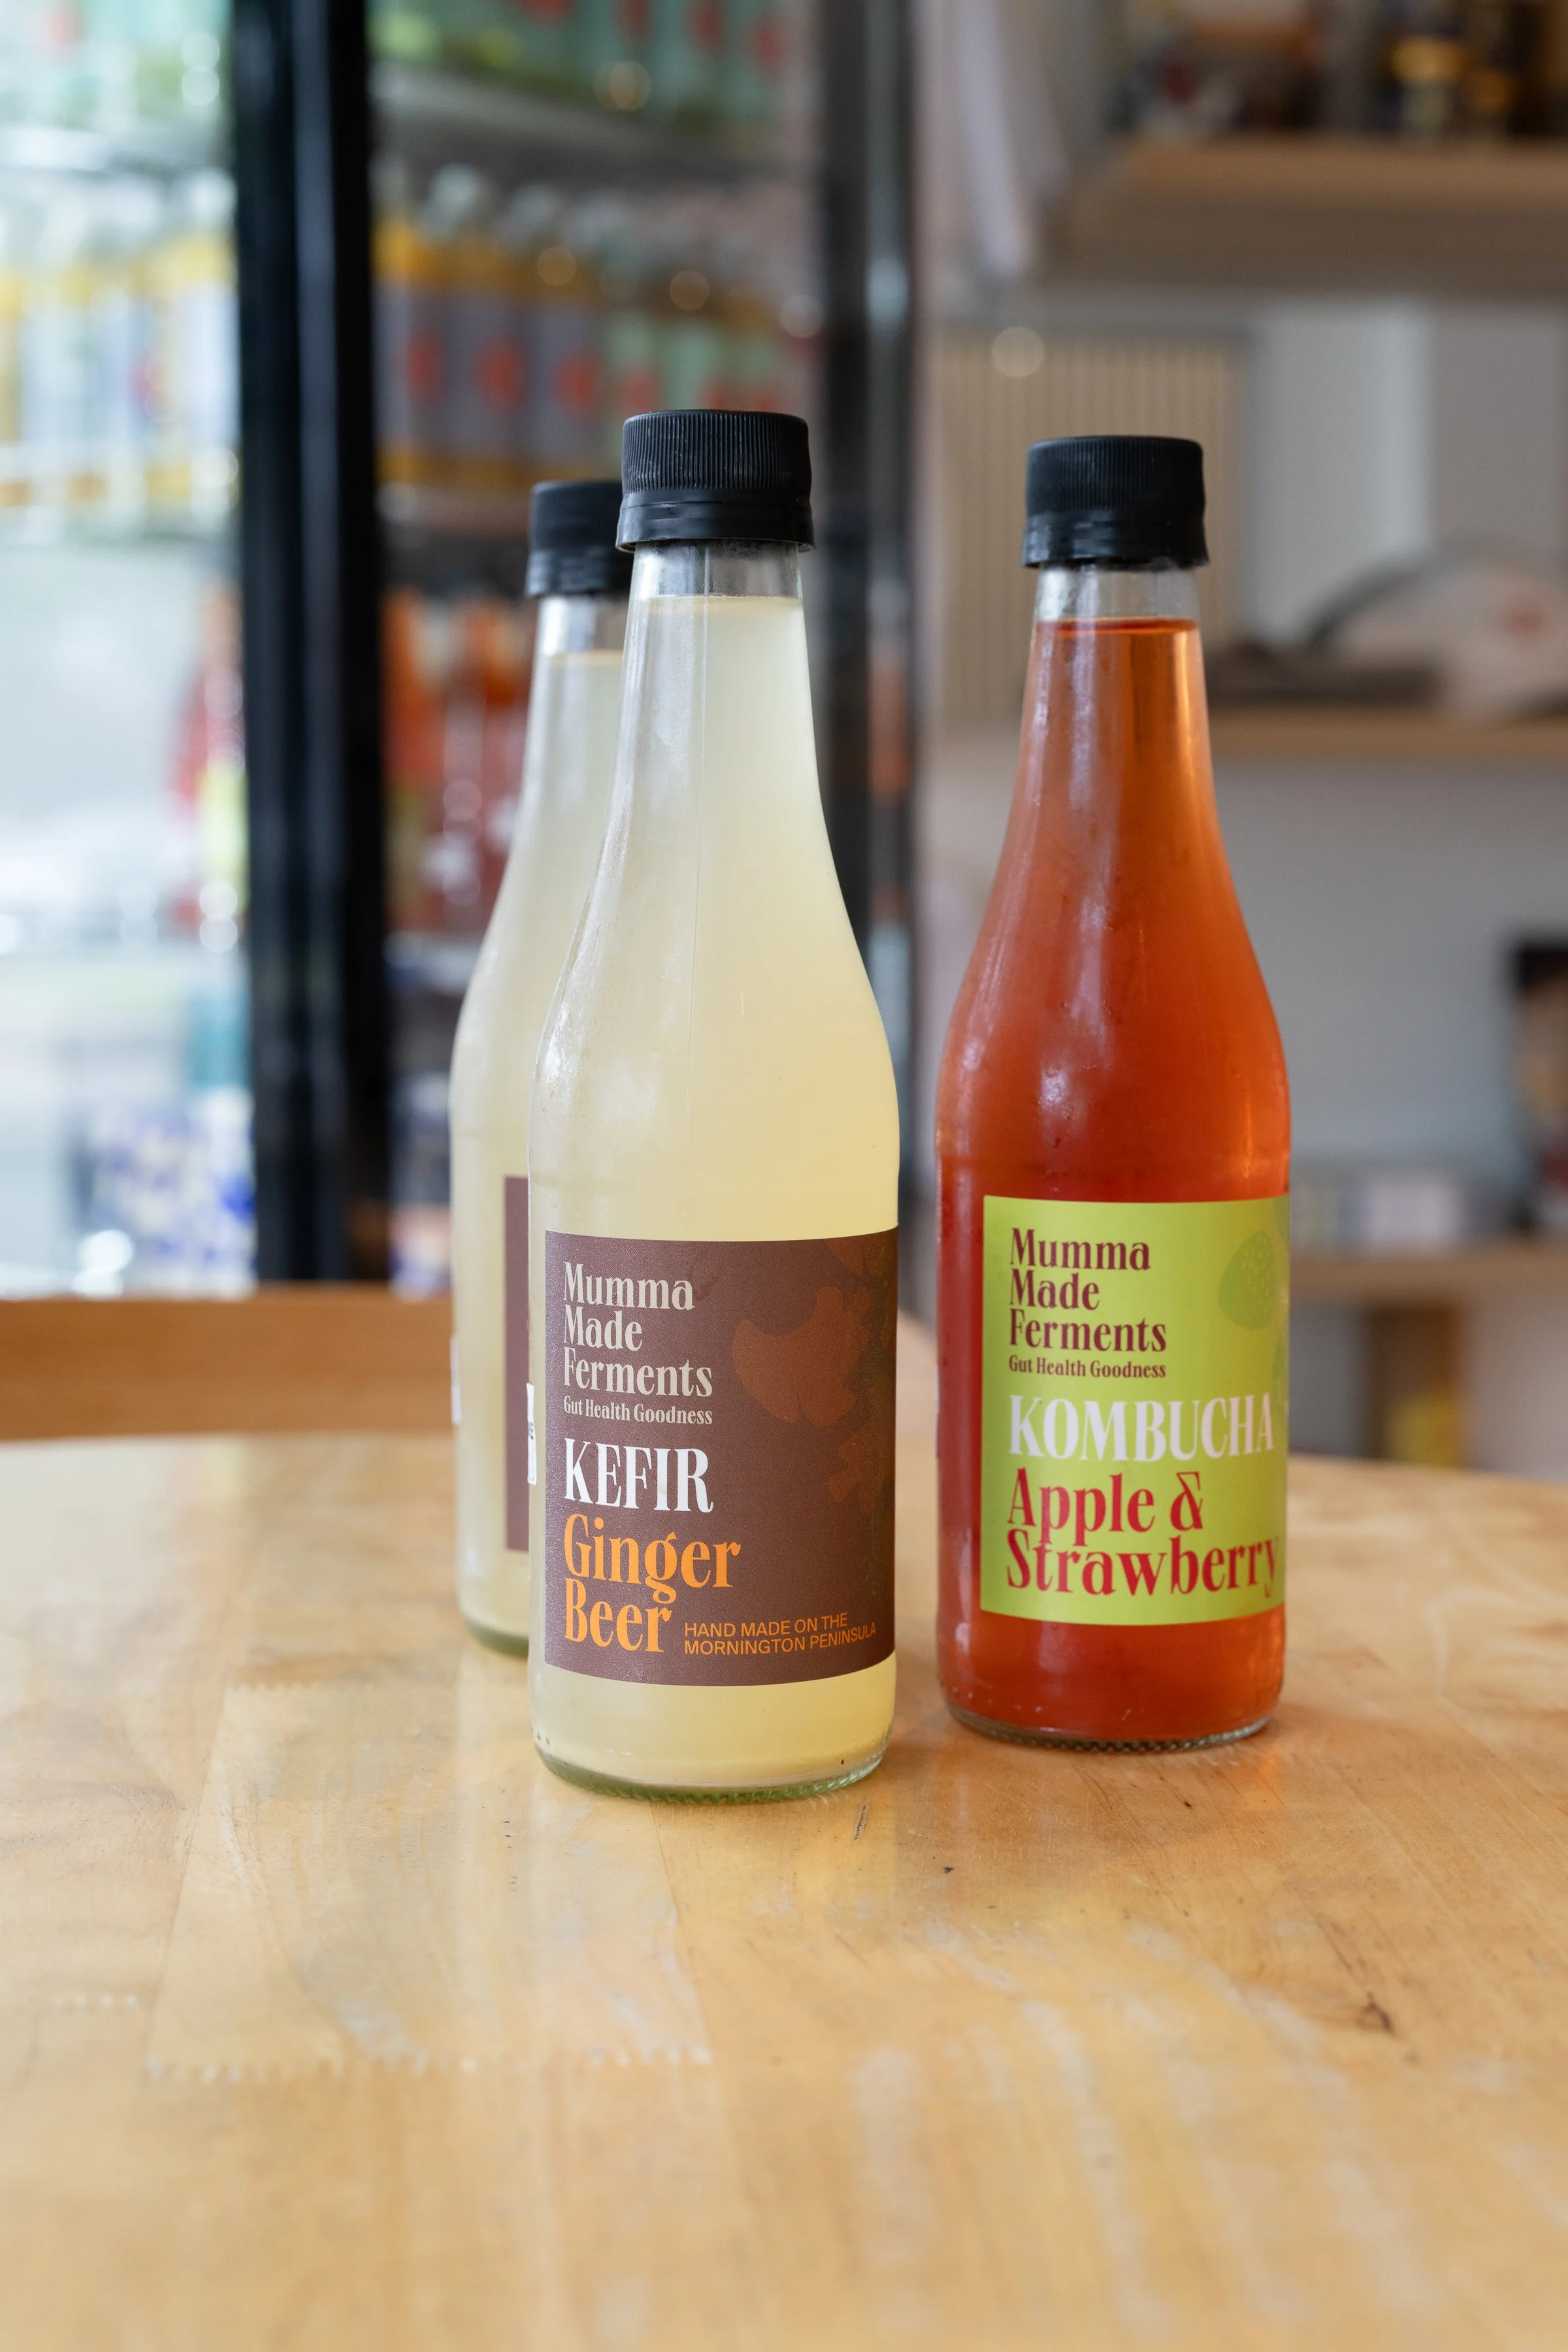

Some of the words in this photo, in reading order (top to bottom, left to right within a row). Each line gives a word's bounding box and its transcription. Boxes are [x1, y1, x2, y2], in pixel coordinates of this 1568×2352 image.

[1010, 1228, 1151, 1271] Mumma
[564, 1262, 695, 1310] Mumma
[1010, 1268, 1100, 1310] Made
[564, 1305, 642, 1351] Made
[1009, 1309, 1167, 1352] Ferments
[563, 1347, 712, 1397] Ferments
[1009, 1354, 1032, 1373] Gut
[1036, 1358, 1086, 1377] Health
[1090, 1360, 1166, 1378] Goodness
[563, 1396, 583, 1416] Gut
[586, 1398, 630, 1422] Health
[634, 1403, 712, 1424] Goodness
[1009, 1393, 1273, 1462] KOMBUCHA
[564, 1438, 713, 1512] KEFIR
[1007, 1467, 1155, 1546] Apple
[1170, 1471, 1203, 1531] &
[564, 1514, 741, 1603] Ginger
[1006, 1528, 1279, 1597] Strawberry
[564, 1578, 672, 1652] Beer
[685, 1621, 736, 1637] HAND
[741, 1619, 790, 1635] MADE
[794, 1618, 817, 1633] ON
[821, 1612, 847, 1629] THE
[685, 1637, 805, 1654] MORNINGTON
[810, 1622, 875, 1649] PENINSULA
